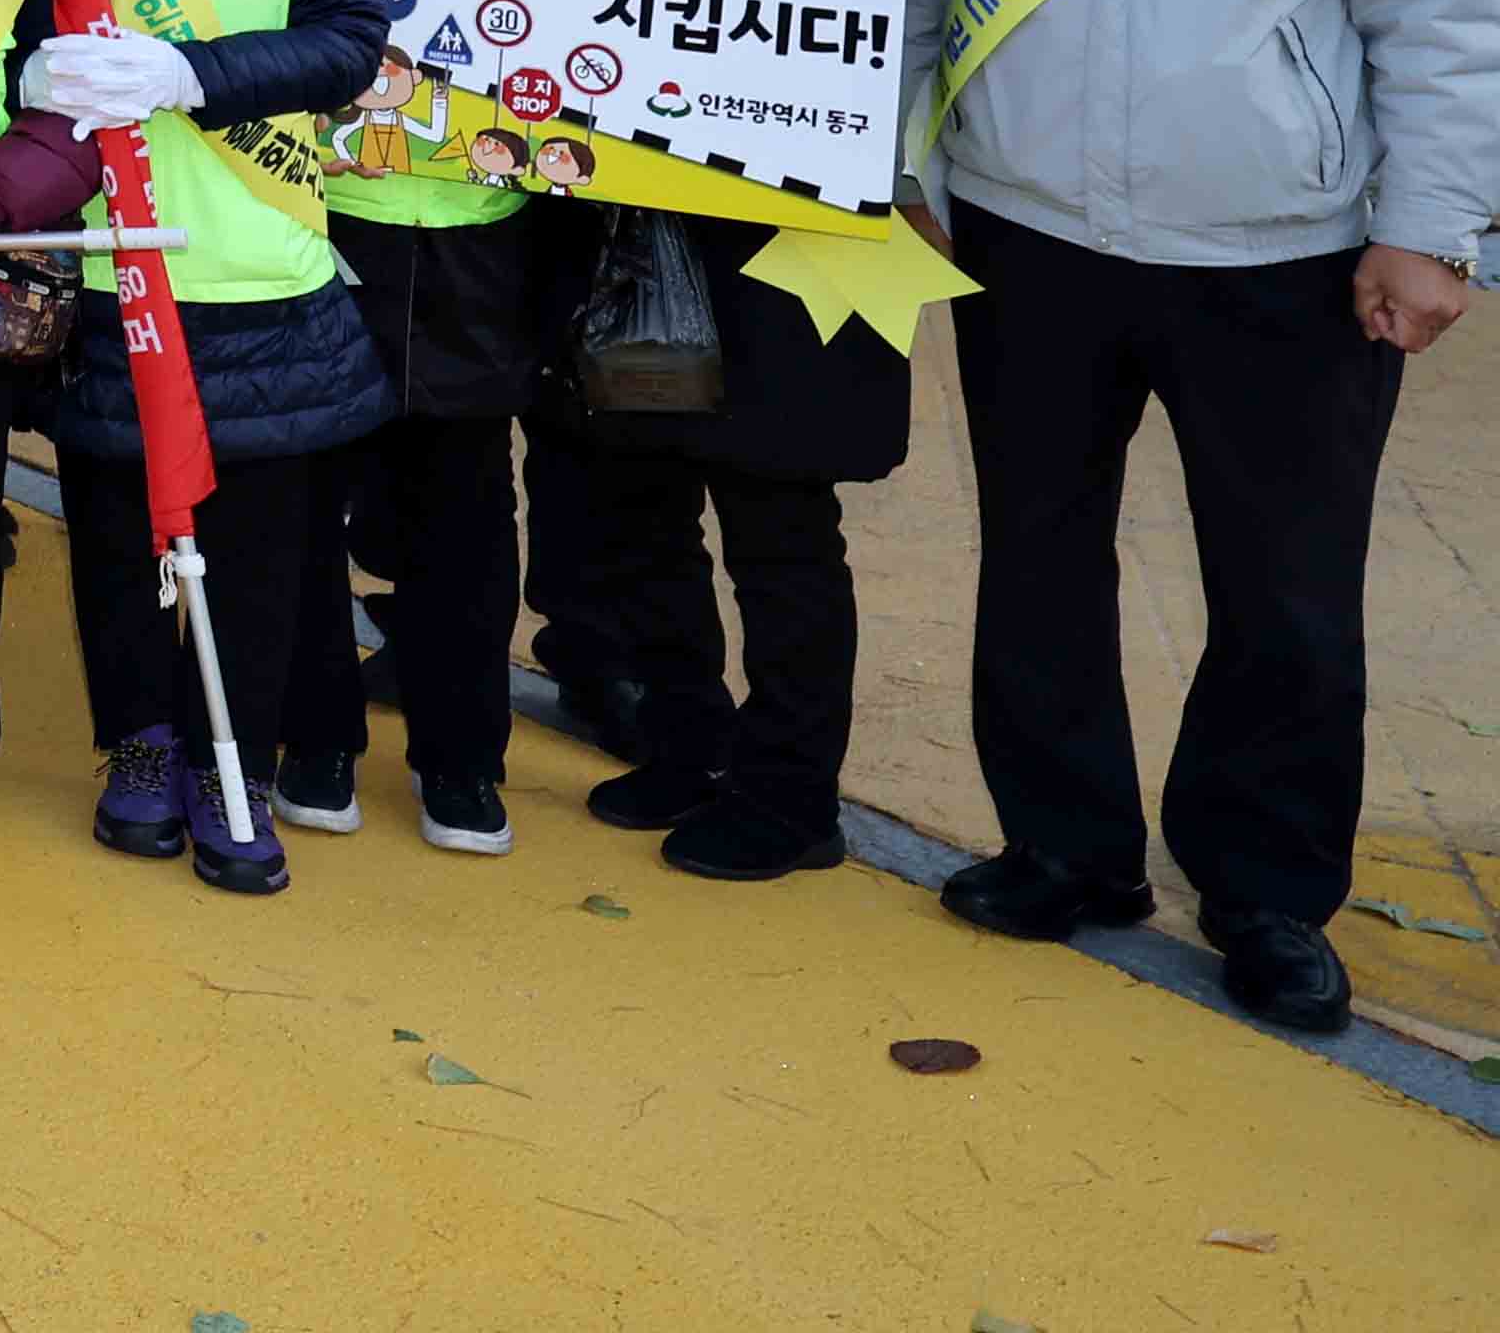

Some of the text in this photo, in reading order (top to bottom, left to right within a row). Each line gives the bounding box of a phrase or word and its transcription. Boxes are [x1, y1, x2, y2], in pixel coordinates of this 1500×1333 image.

[489, 8, 519, 33] 30
[511, 74, 553, 96] 정지
[512, 94, 551, 115] STOP
[698, 92, 870, 134] 인천광역시 동구
